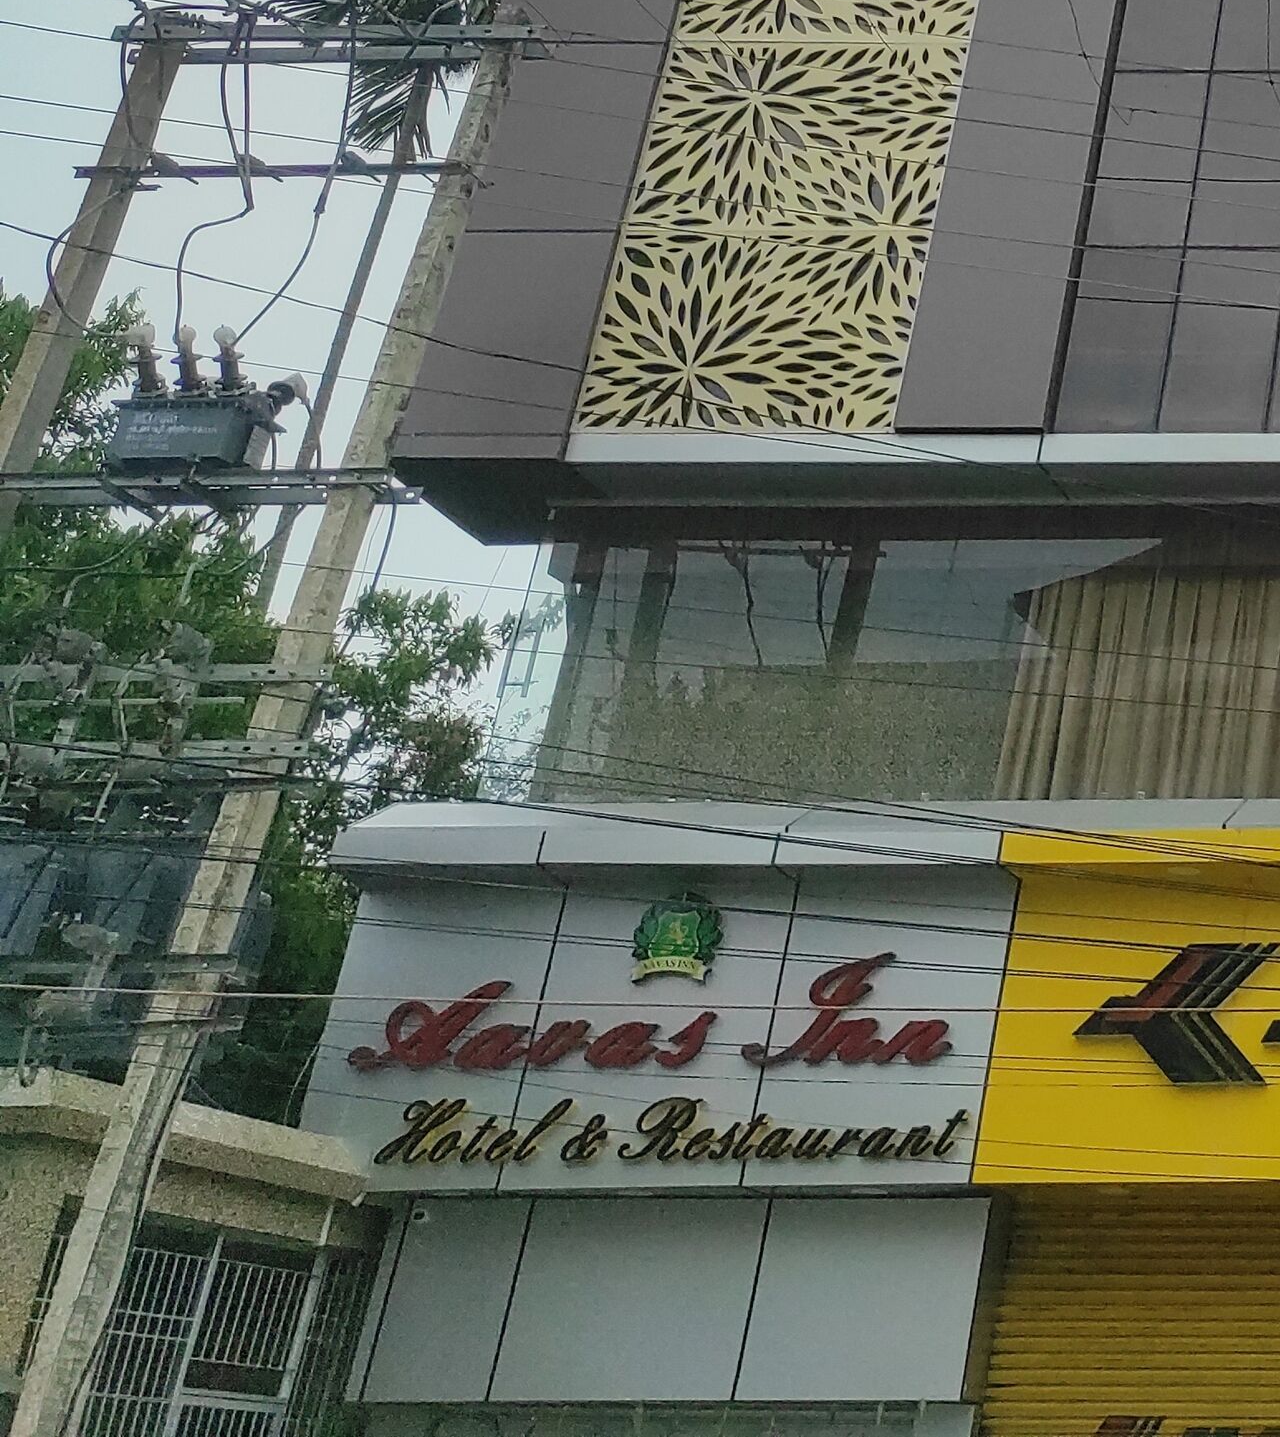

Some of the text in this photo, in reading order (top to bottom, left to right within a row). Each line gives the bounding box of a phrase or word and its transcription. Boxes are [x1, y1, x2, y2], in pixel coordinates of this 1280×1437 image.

[347, 951, 953, 1070] Aavas Inn
[374, 1096, 968, 1164] Hotel & Restaurant
